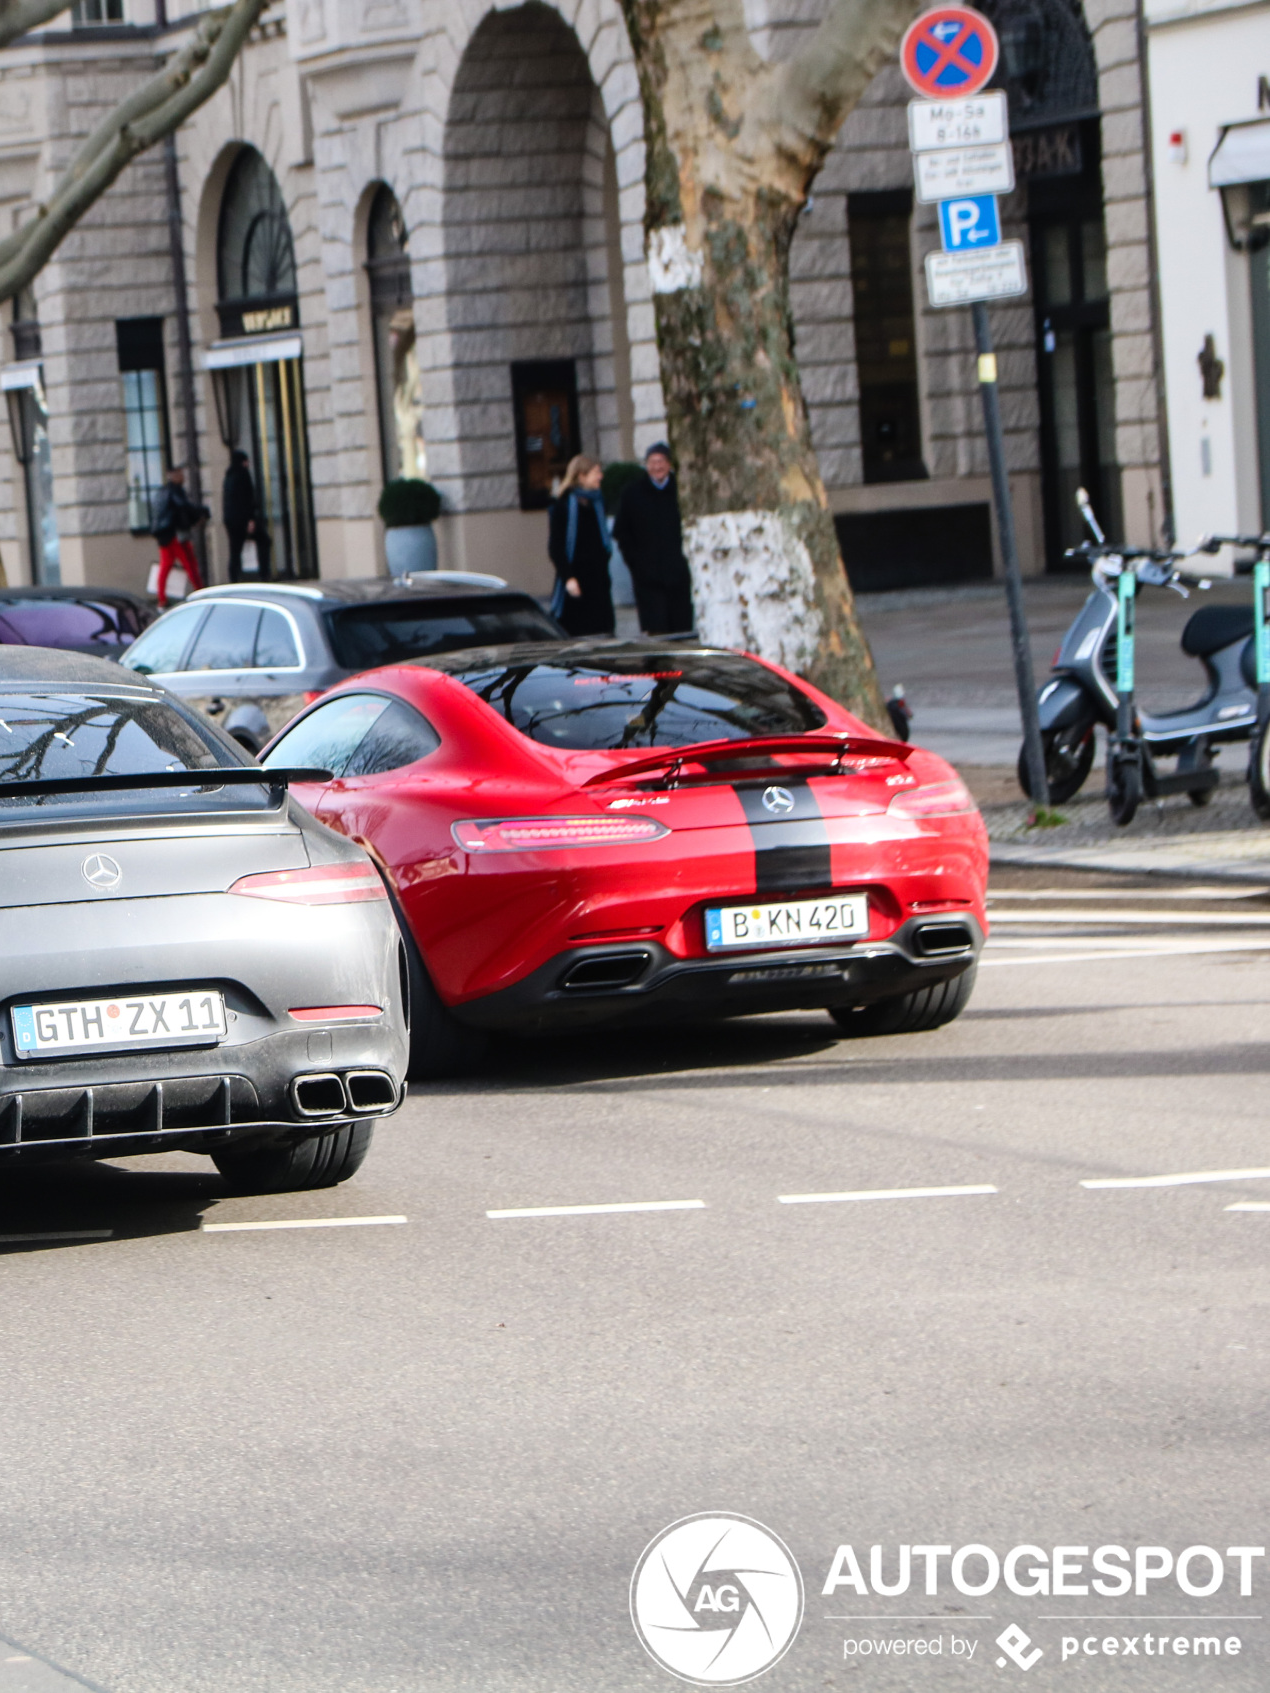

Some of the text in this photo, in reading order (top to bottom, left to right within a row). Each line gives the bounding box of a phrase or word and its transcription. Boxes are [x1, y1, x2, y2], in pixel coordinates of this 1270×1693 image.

[930, 104, 986, 121] Mo-Sa
[948, 200, 981, 247] P
[733, 911, 749, 938] B
[768, 907, 802, 935] KN
[808, 903, 855, 932] 420
[22, 997, 220, 1042] D GTH ZX 11
